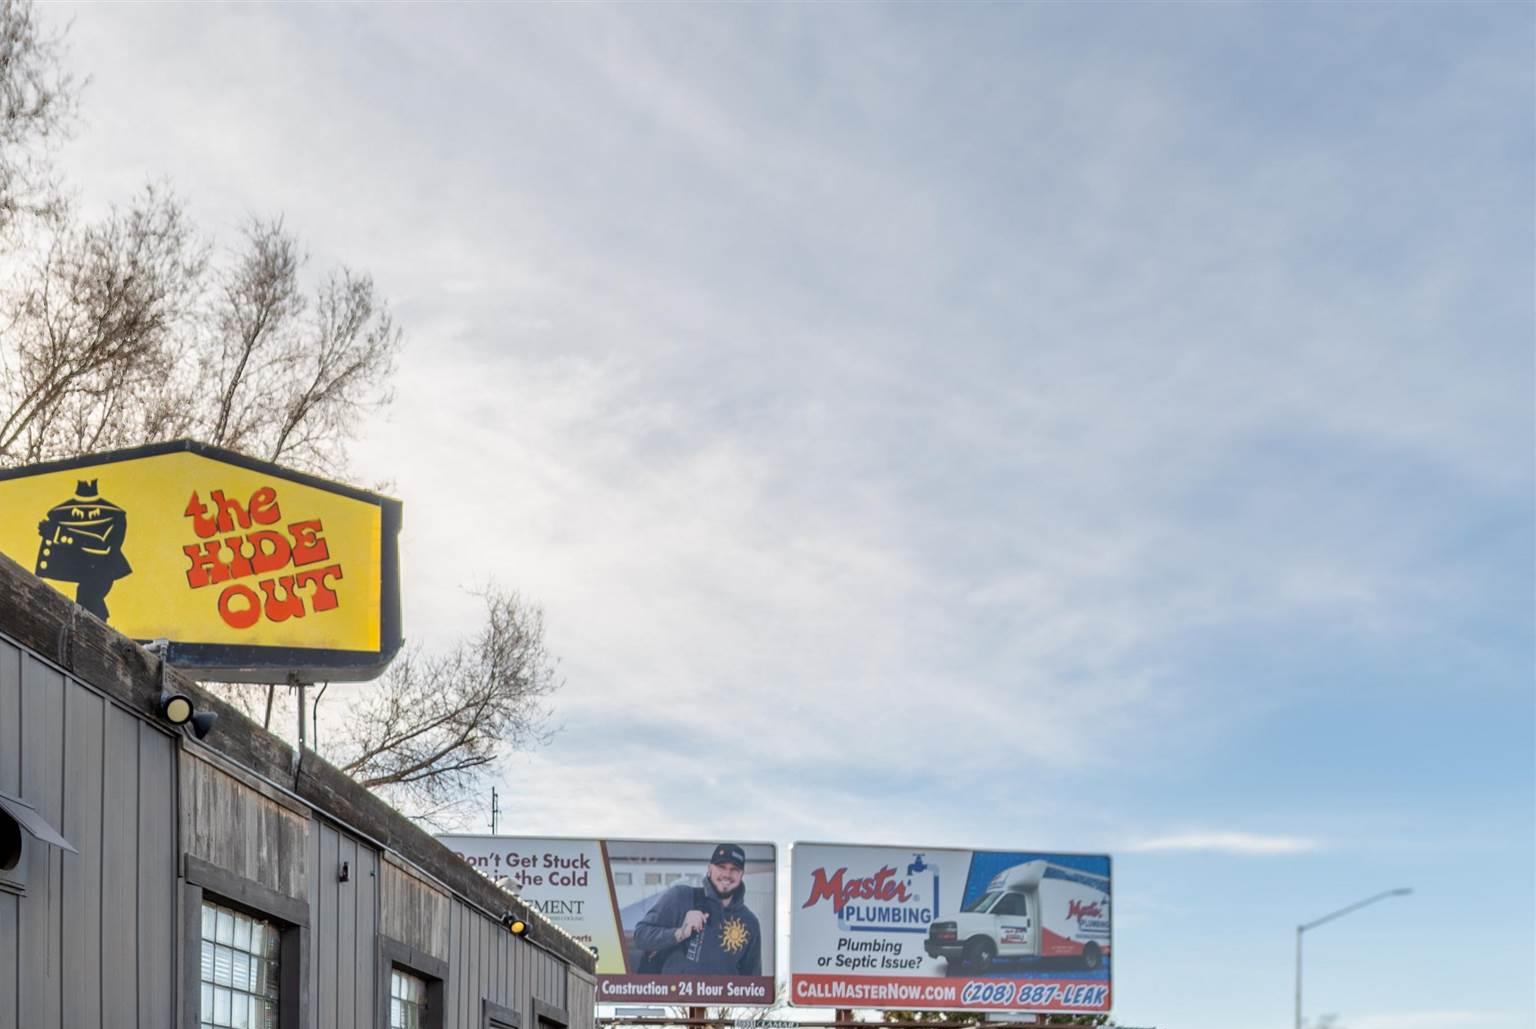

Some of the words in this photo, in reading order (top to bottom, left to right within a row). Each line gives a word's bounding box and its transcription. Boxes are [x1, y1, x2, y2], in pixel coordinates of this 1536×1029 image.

[184, 486, 281, 539] the
[182, 519, 330, 589] HIDE
[217, 564, 343, 629] OUT
[506, 852, 538, 867] Get
[543, 852, 590, 869] Stuck
[515, 869, 543, 886] the
[548, 871, 588, 886] Cold
[801, 864, 912, 913] Master
[845, 906, 931, 923] PLUMBING
[837, 938, 902, 955] Plumbing
[817, 956, 832, 967] or
[835, 954, 877, 970] Septic
[881, 956, 923, 969] Issue?
[602, 980, 668, 995] Construction
[678, 981, 693, 996] 24
[697, 982, 723, 996] Hour
[727, 983, 765, 997] Service
[961, 980, 1016, 1005] (208)
[1017, 983, 1108, 1007] 887-LEAK
